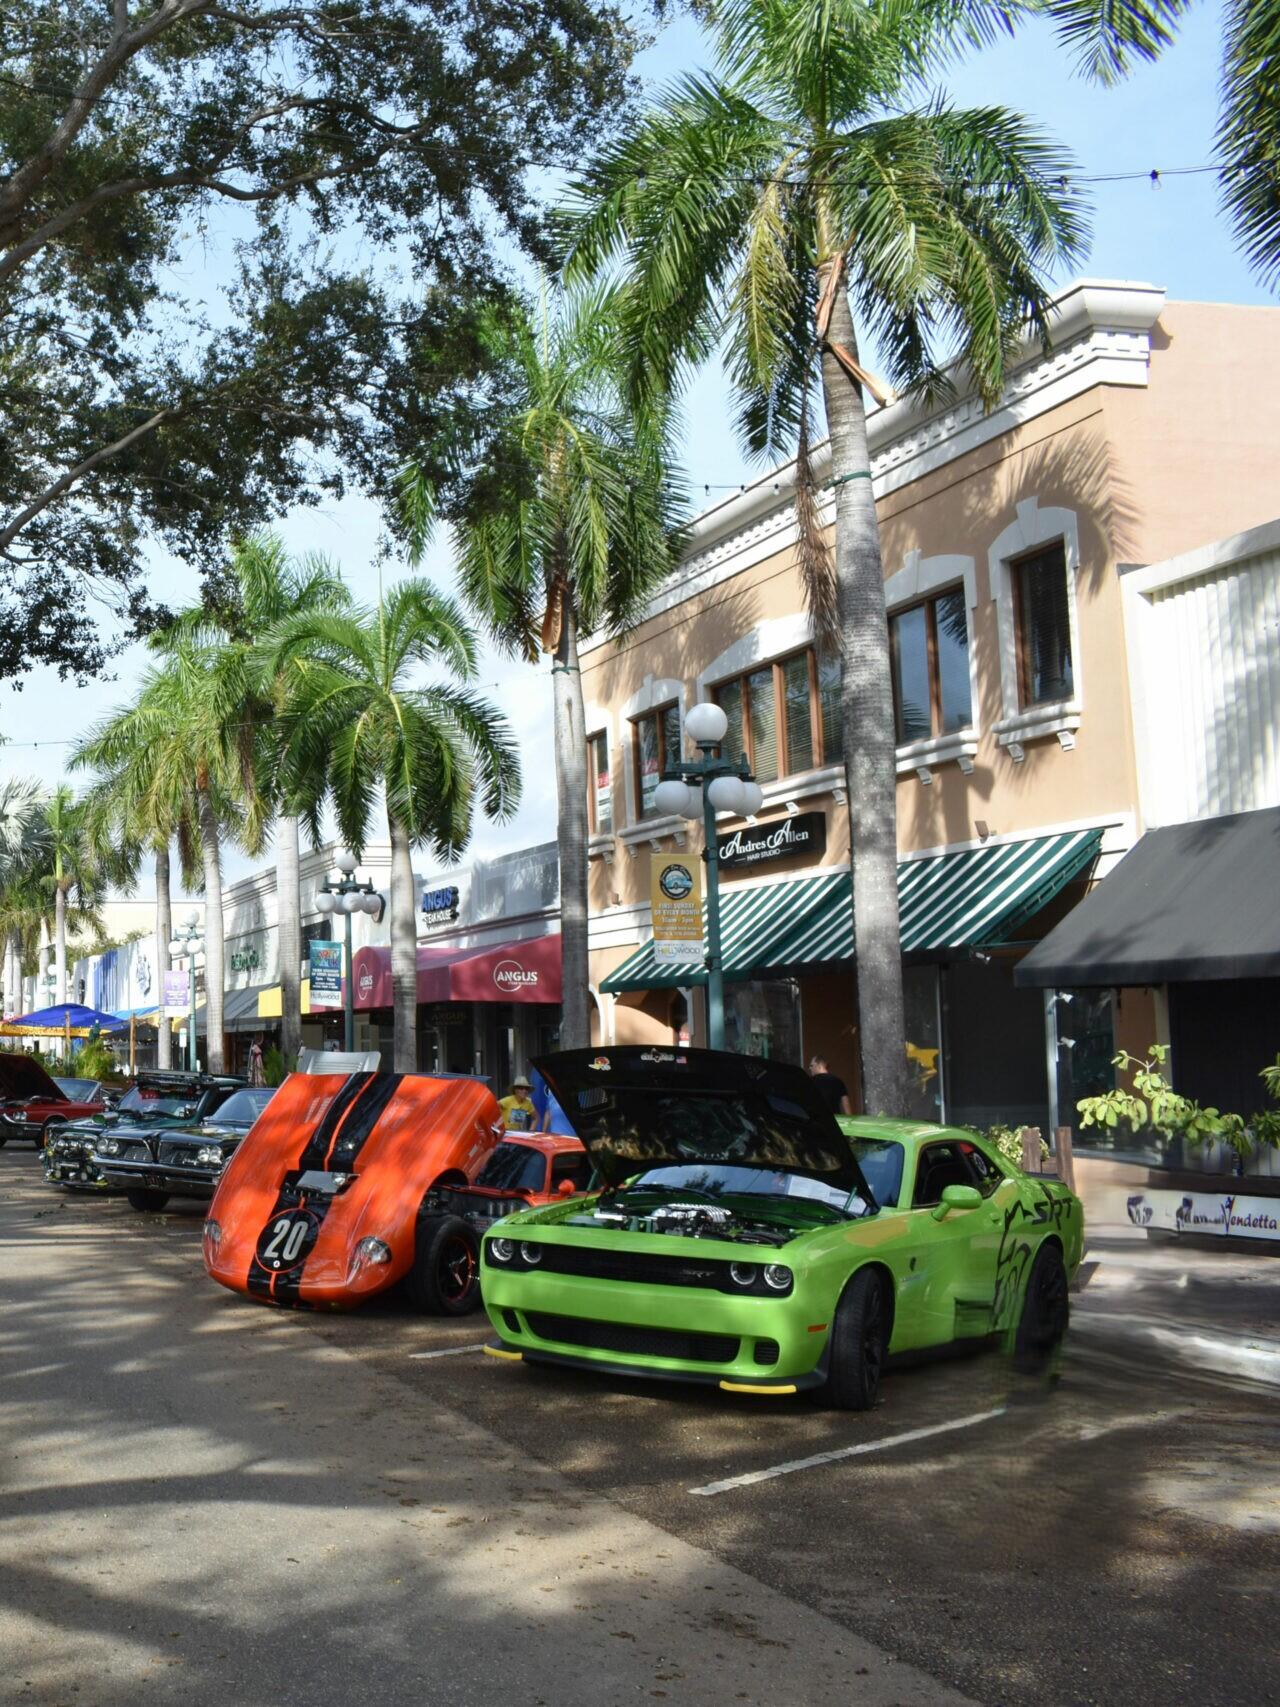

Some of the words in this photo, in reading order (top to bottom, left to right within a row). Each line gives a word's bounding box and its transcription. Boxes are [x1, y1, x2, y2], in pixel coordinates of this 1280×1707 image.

[720, 831, 766, 859] Andres
[767, 819, 809, 848] Allen
[761, 848, 781, 858] STUDIO
[421, 886, 453, 912] ANGUS
[497, 971, 538, 982] ANGUS
[1031, 1197, 1072, 1231] SRT
[1220, 1196, 1277, 1236] Vendetta
[263, 1218, 309, 1261] 20
